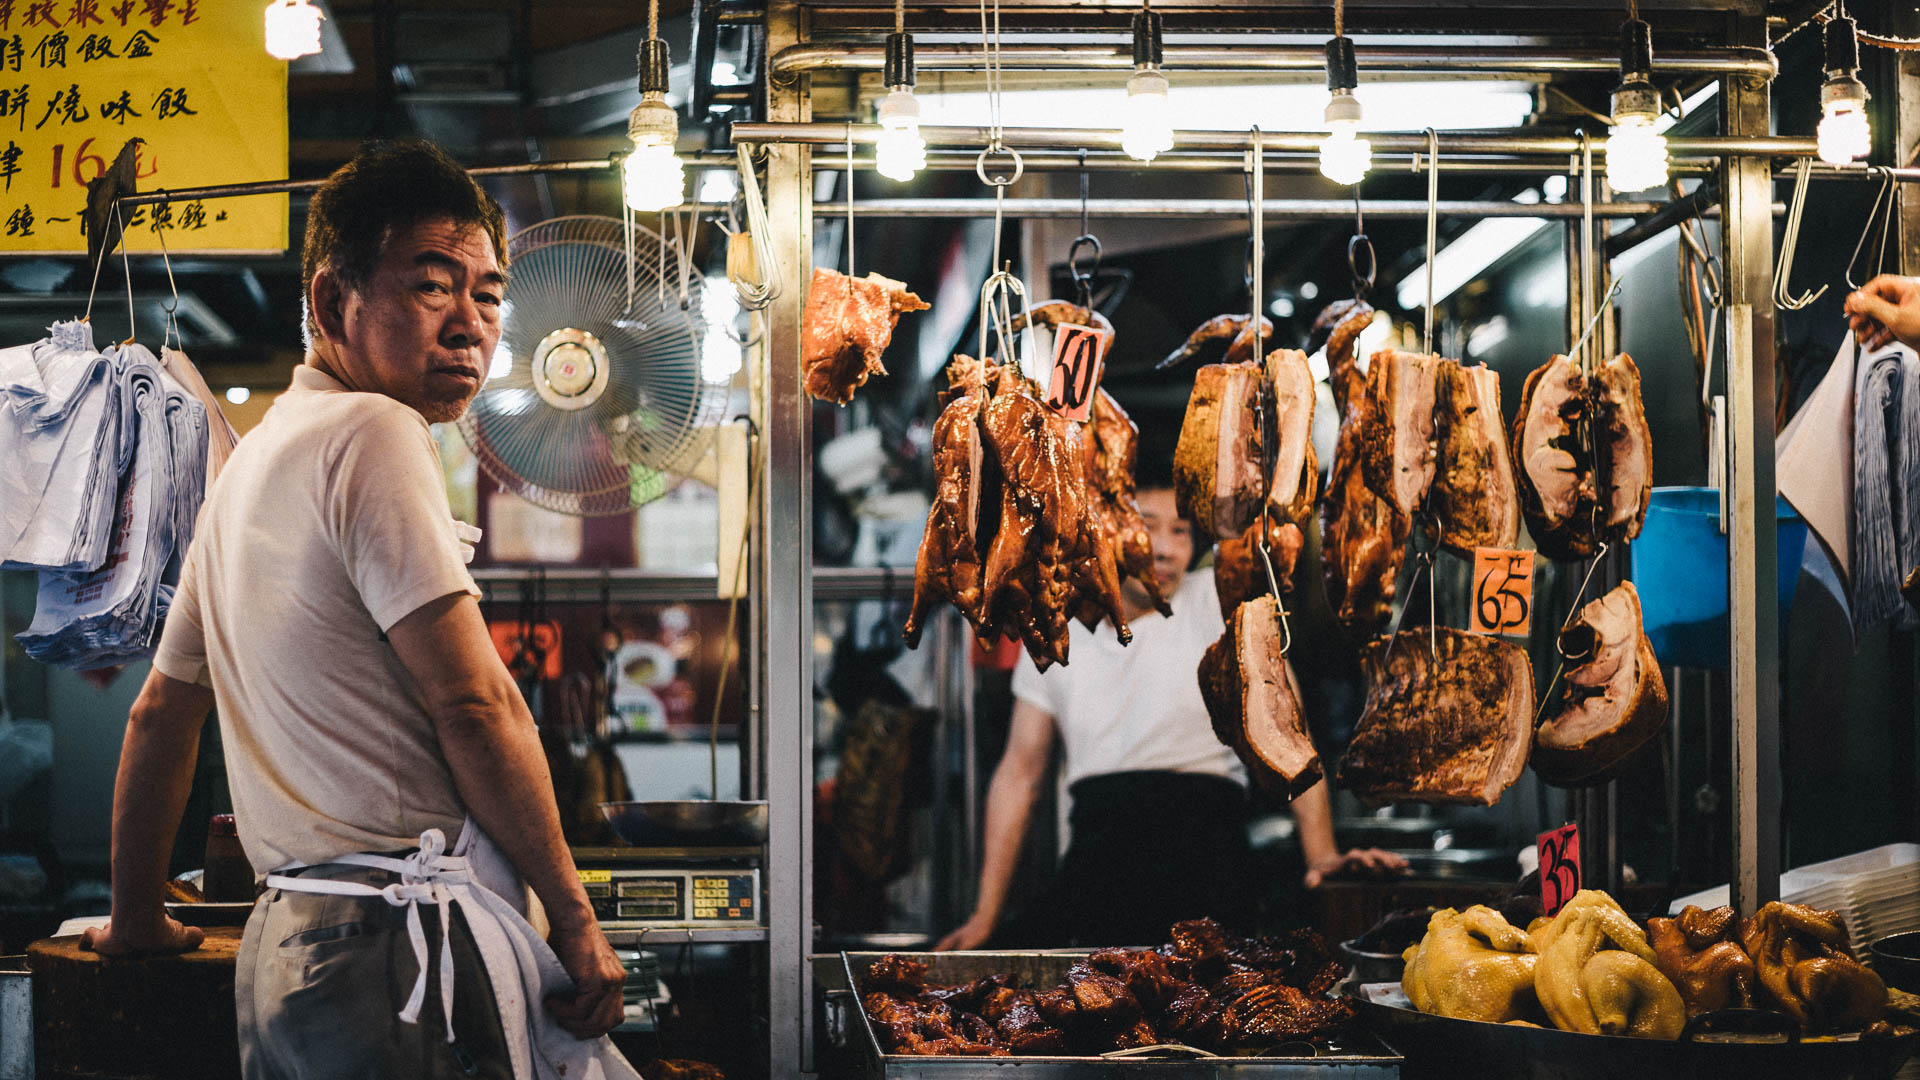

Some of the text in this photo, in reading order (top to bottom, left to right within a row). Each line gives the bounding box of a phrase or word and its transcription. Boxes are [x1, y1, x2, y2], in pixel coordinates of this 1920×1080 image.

[1049, 329, 1098, 410] 50
[1477, 567, 1529, 630] 65
[1541, 829, 1579, 917] 35
